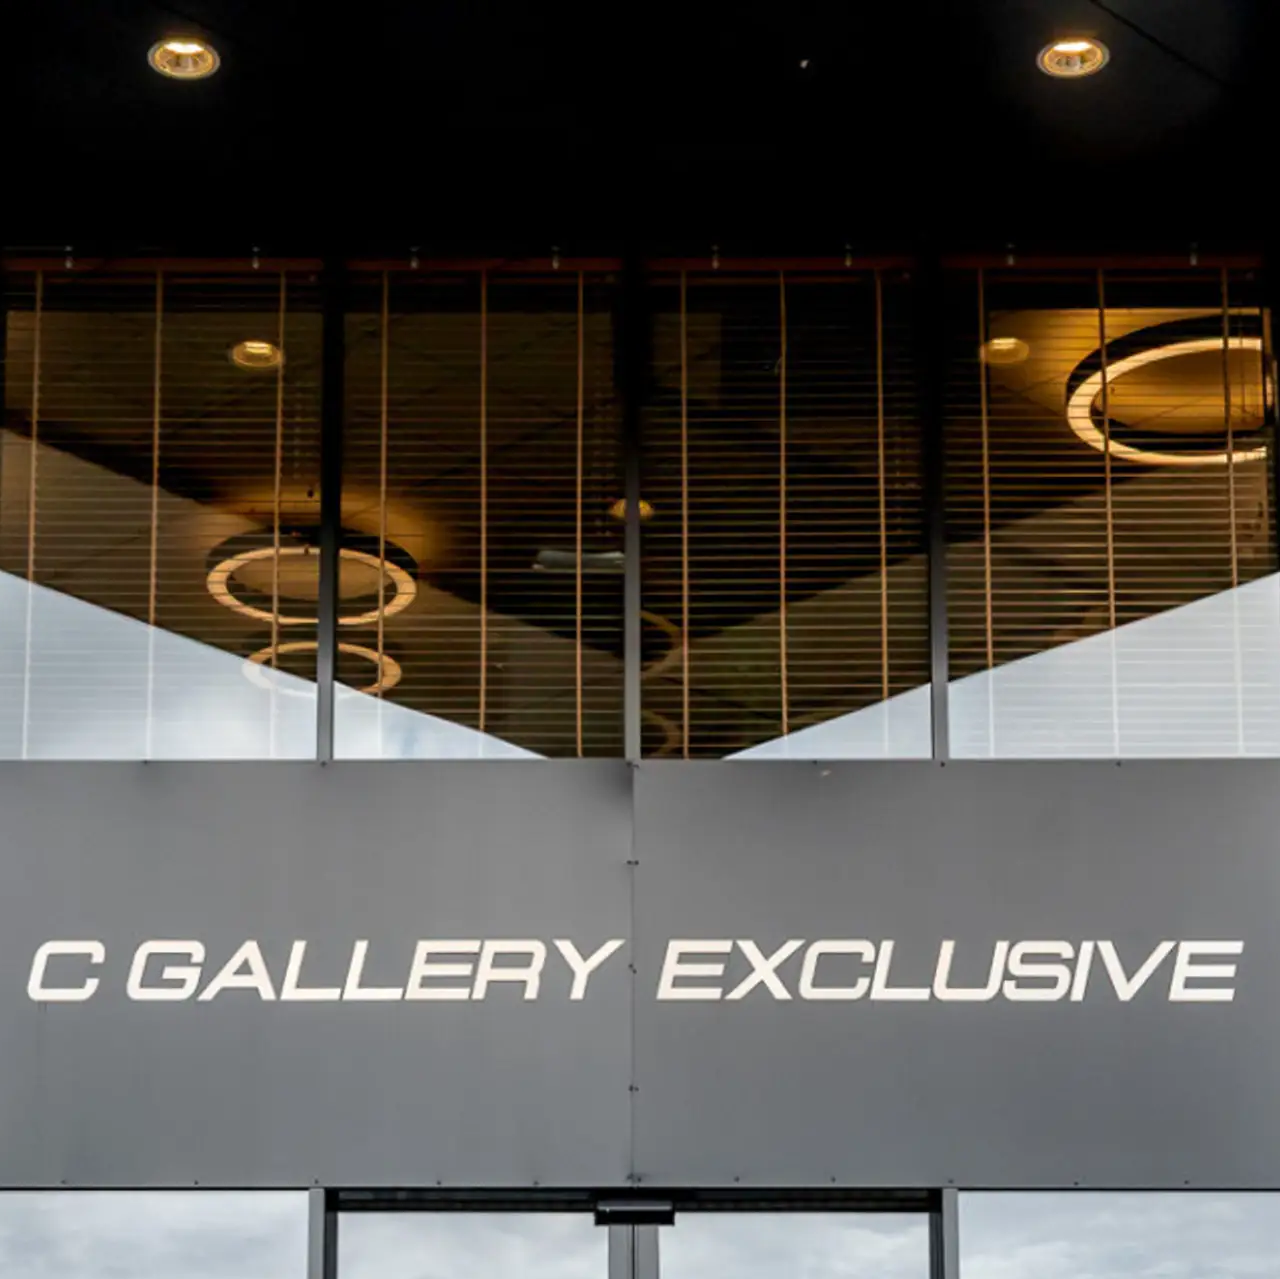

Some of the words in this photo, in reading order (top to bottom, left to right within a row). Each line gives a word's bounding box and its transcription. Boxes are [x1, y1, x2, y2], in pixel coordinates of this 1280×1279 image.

[26, 938, 107, 1001] C
[125, 938, 627, 1001] GALLERY
[656, 938, 1246, 1002] EXCLUSIVE
